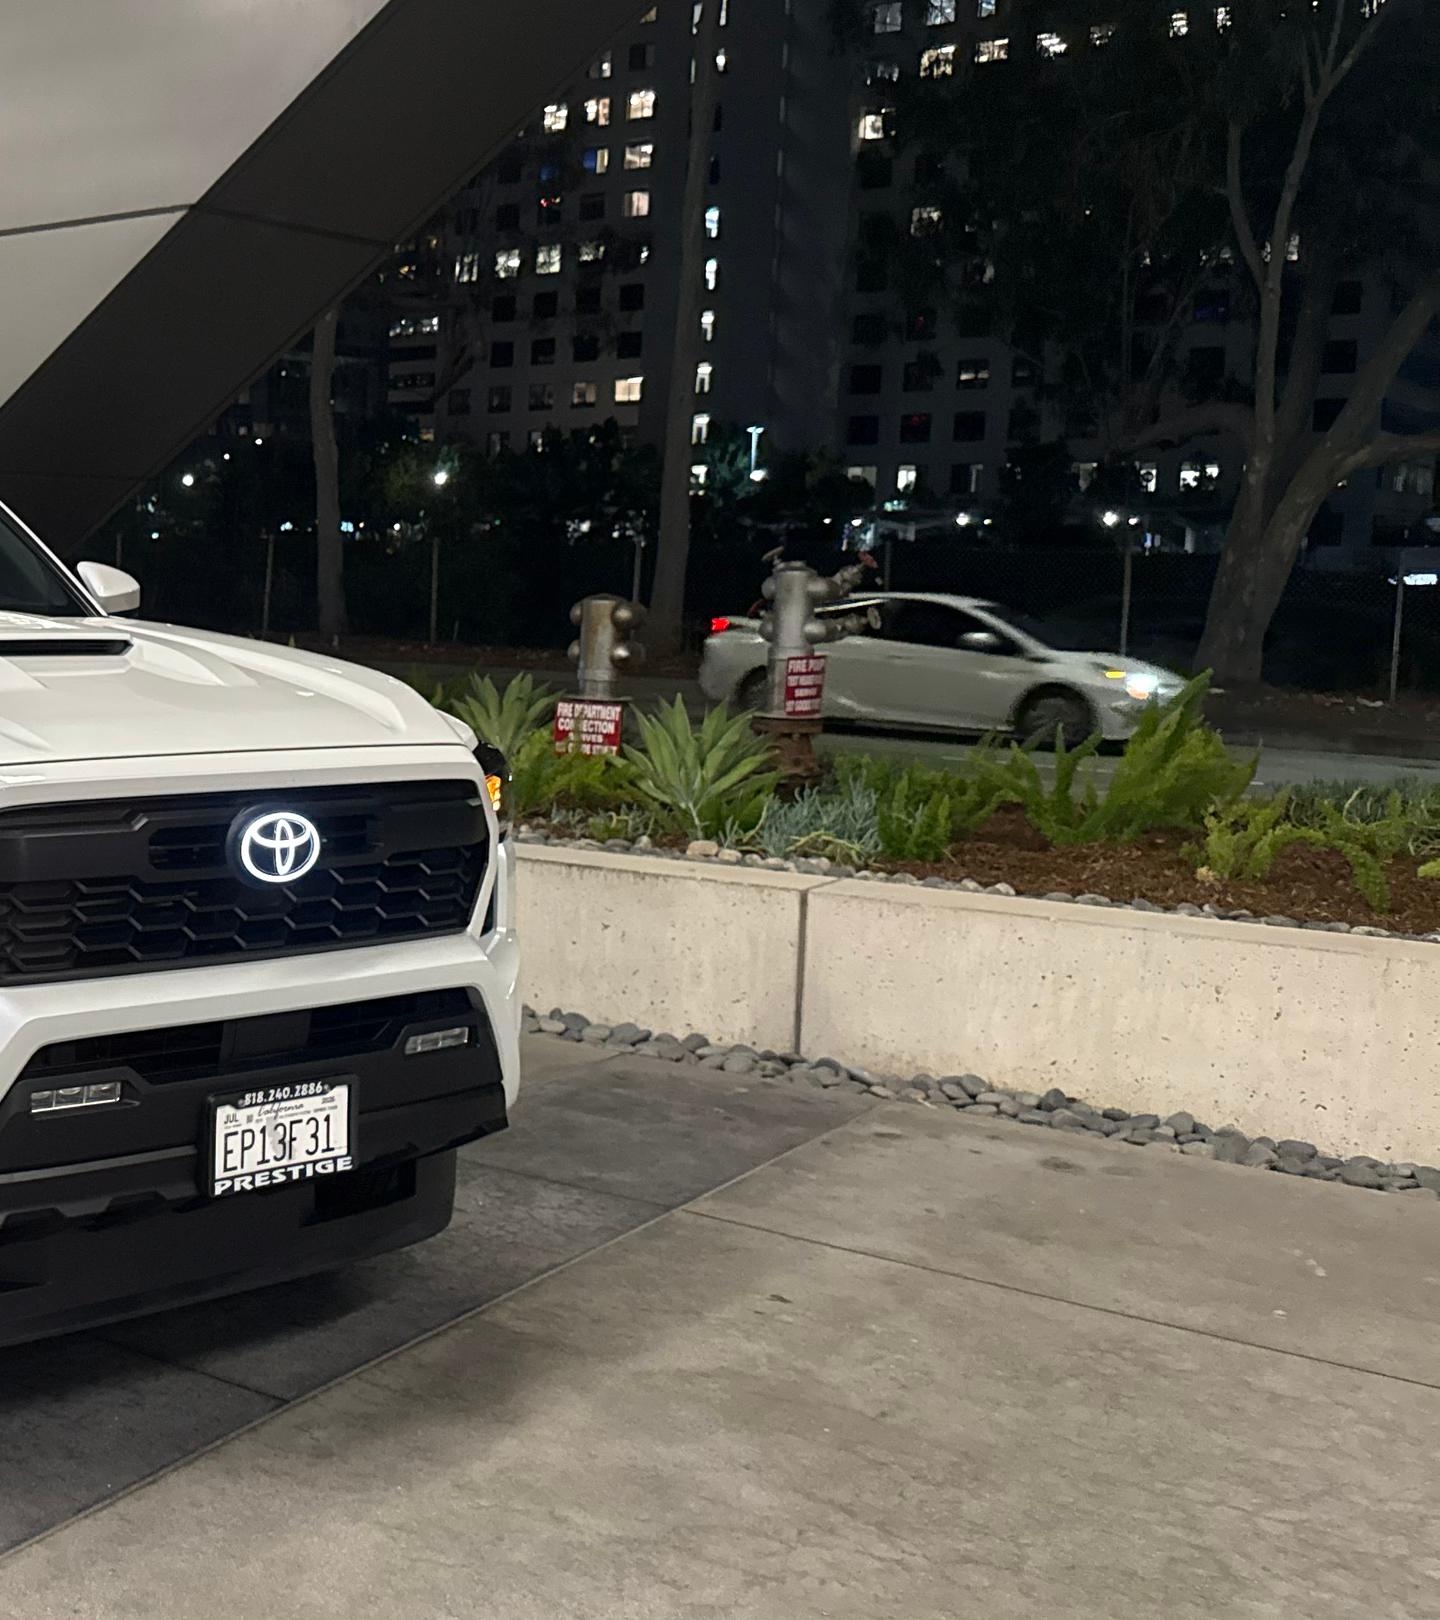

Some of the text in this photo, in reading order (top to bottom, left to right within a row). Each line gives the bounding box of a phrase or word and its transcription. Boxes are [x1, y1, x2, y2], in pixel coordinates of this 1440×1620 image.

[244, 1081, 323, 1106] 818.240.2886
[225, 1114, 239, 1124] JUL
[223, 1114, 335, 1173] EP13F31
[214, 1156, 353, 1196] PRESTIGE
